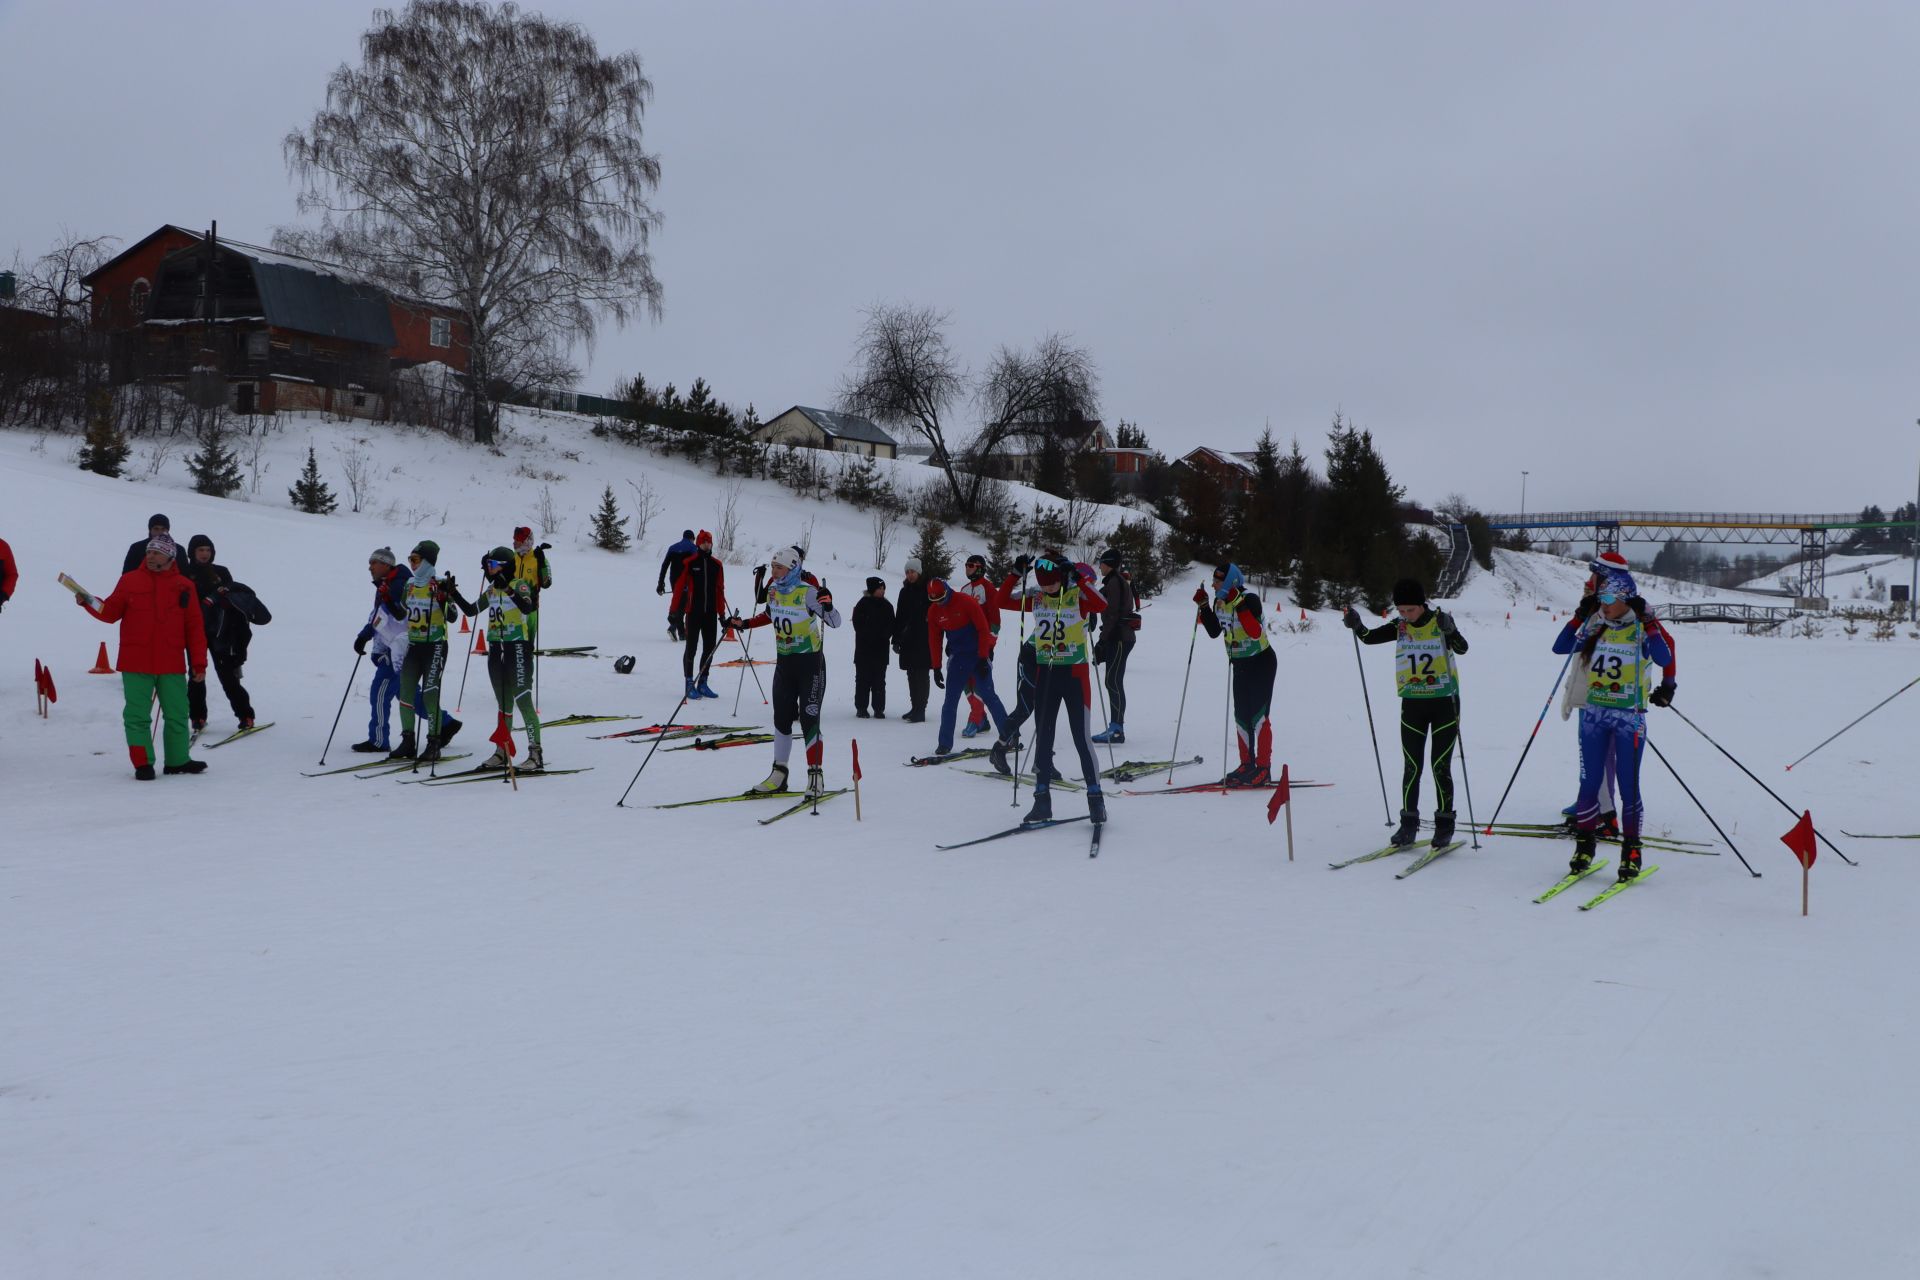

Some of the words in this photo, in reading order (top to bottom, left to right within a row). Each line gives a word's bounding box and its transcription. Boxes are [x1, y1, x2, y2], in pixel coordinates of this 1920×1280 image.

[774, 616, 792, 635] 40
[1039, 620, 1065, 640] 28
[426, 644, 442, 687] ТАТАРСТАН
[515, 643, 525, 688] ТАТАРСТАН
[1407, 653, 1435, 675] 12
[1591, 654, 1622, 679] 43
